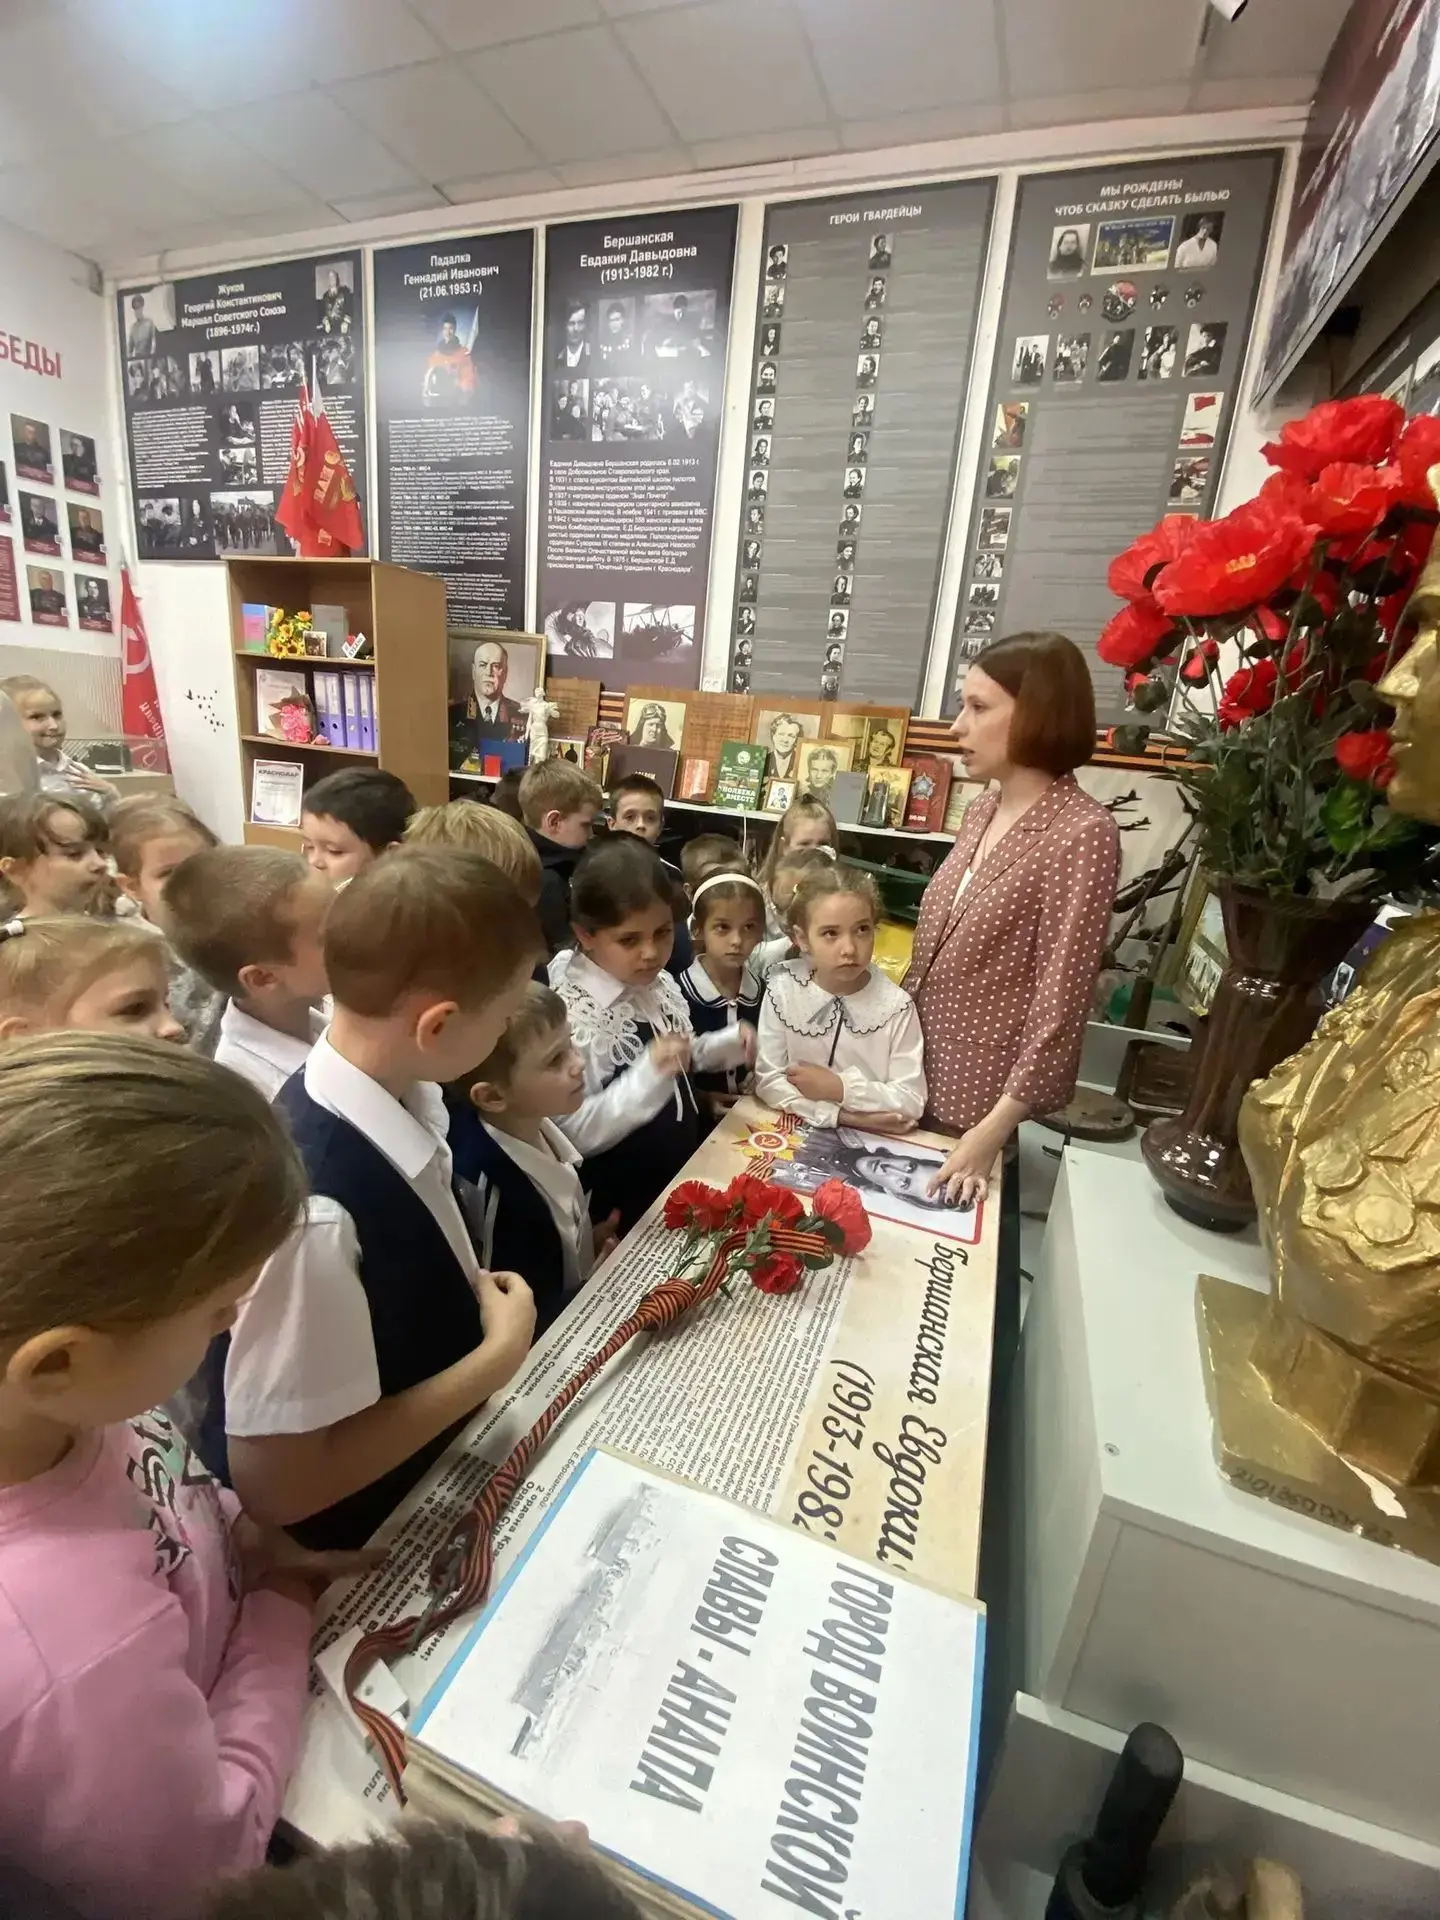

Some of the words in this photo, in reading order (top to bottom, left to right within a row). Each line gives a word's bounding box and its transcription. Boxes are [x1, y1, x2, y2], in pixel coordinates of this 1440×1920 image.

[1100, 184, 1121, 198] МЫ
[1122, 178, 1184, 197] РОЖДЕНЫ
[829, 211, 861, 226] ГЕРОИ
[862, 204, 923, 223] ГВАРДЕЙЦЫ
[1055, 204, 1084, 218] ЧТОБ
[1085, 199, 1129, 215] СКАЗКУ
[1130, 194, 1183, 212] СДЕЛАТЬ
[1184, 189, 1231, 205] БЫЛЬЮ
[603, 230, 674, 250] Бершанская
[430, 252, 471, 268] Падалка
[580, 252, 627, 269] Евдакия
[629, 245, 698, 266] Давыдовна
[403, 270, 448, 286] Геннадий
[450, 264, 500, 281] Иванович
[600, 265, 660, 285] (1913-1982
[661, 263, 674, 279] г.)
[184, 300, 215, 314] Георгий
[216, 291, 282, 309] Константинович
[419, 283, 470, 301] (21.06.1953
[472, 281, 483, 296] г.)
[214, 309, 258, 324] Советского
[259, 305, 287, 317] Союза
[907, 1243, 968, 1404] Бершанская
[764, 1399, 785, 1439] командиром
[777, 1419, 799, 1465] Гражданской
[758, 1444, 779, 1486] Батайскую
[873, 1414, 947, 1570] Евдоки
[505, 1494, 537, 1533] ордена
[690, 1537, 778, 1656] СЛАВЫ
[803, 1563, 893, 1683] ГОРОД
[630, 1660, 736, 1813] АНАПА
[761, 1670, 876, 1920] ВОИНСКОЙ
